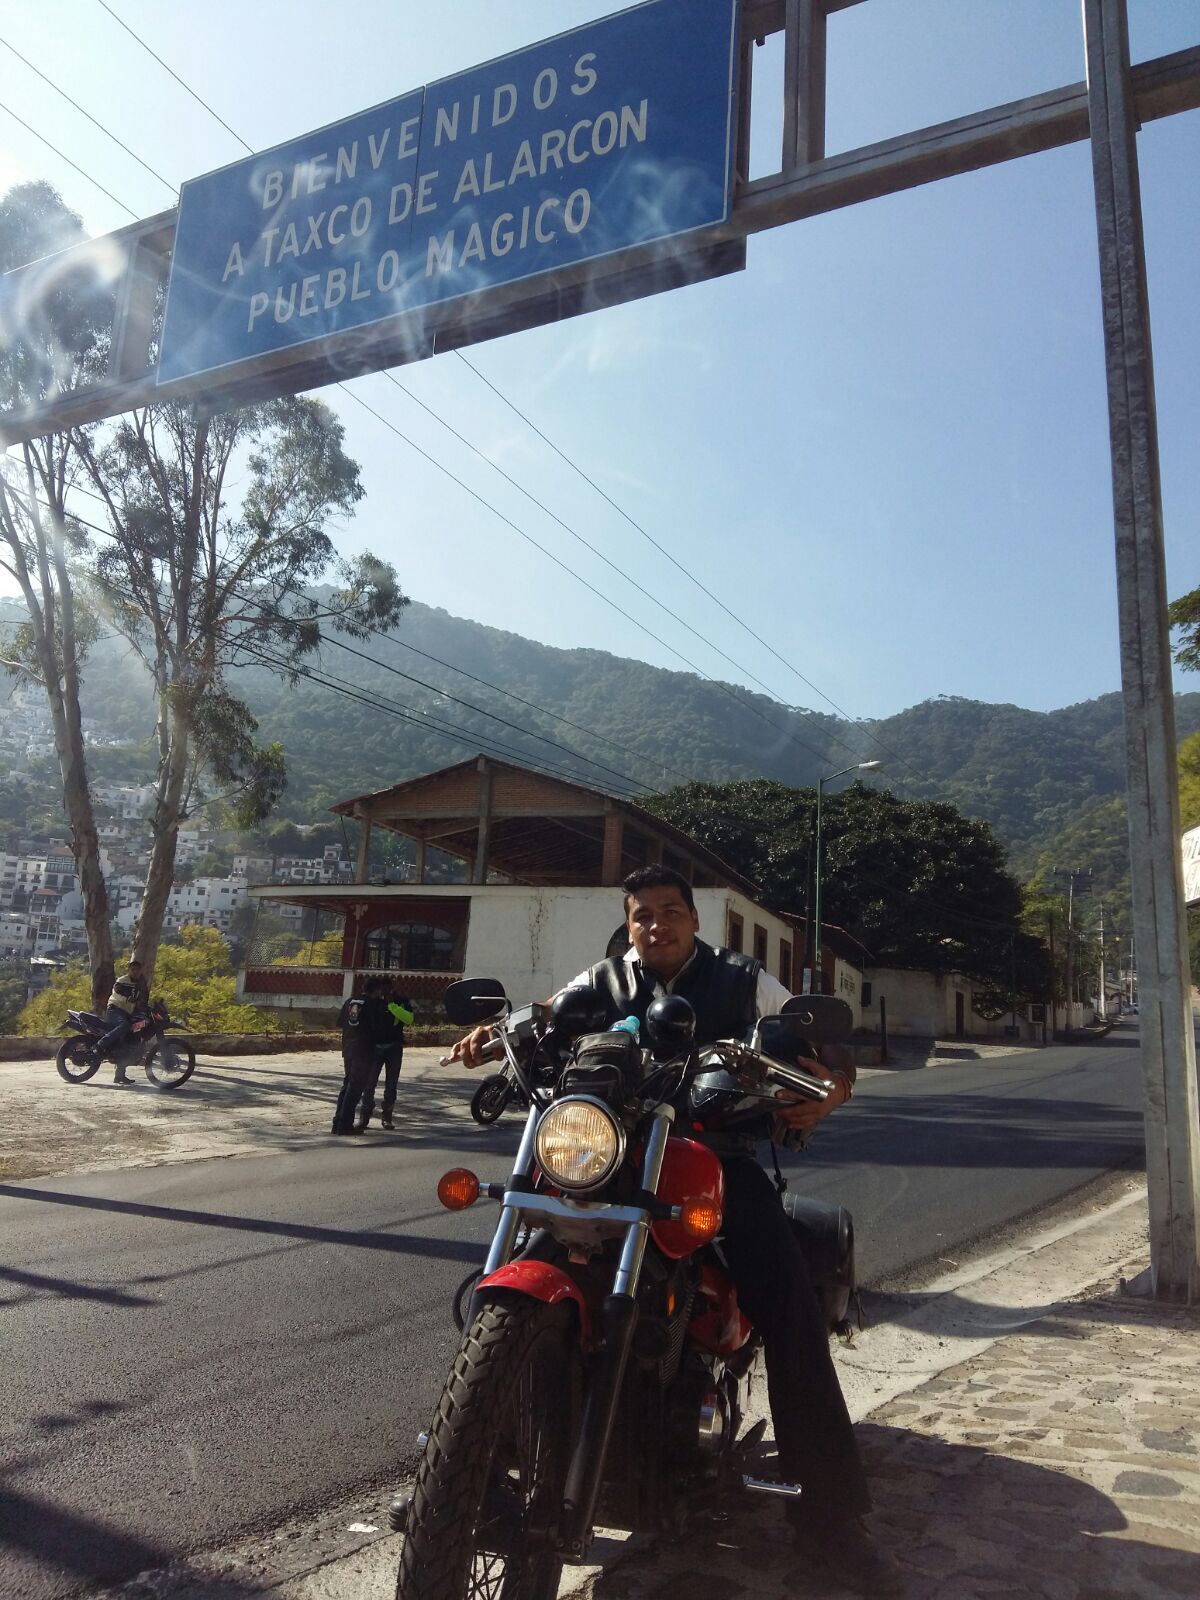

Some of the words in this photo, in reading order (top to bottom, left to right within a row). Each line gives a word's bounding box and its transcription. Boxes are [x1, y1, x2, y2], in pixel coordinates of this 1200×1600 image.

[221, 242, 245, 282] A
[261, 196, 372, 267] TAXCO
[388, 171, 439, 225] DE
[452, 98, 649, 203] ALARCON
[262, 53, 597, 210] BIENVENIDOS
[247, 249, 399, 333] PUEBLO
[425, 187, 591, 277] MAGICO
